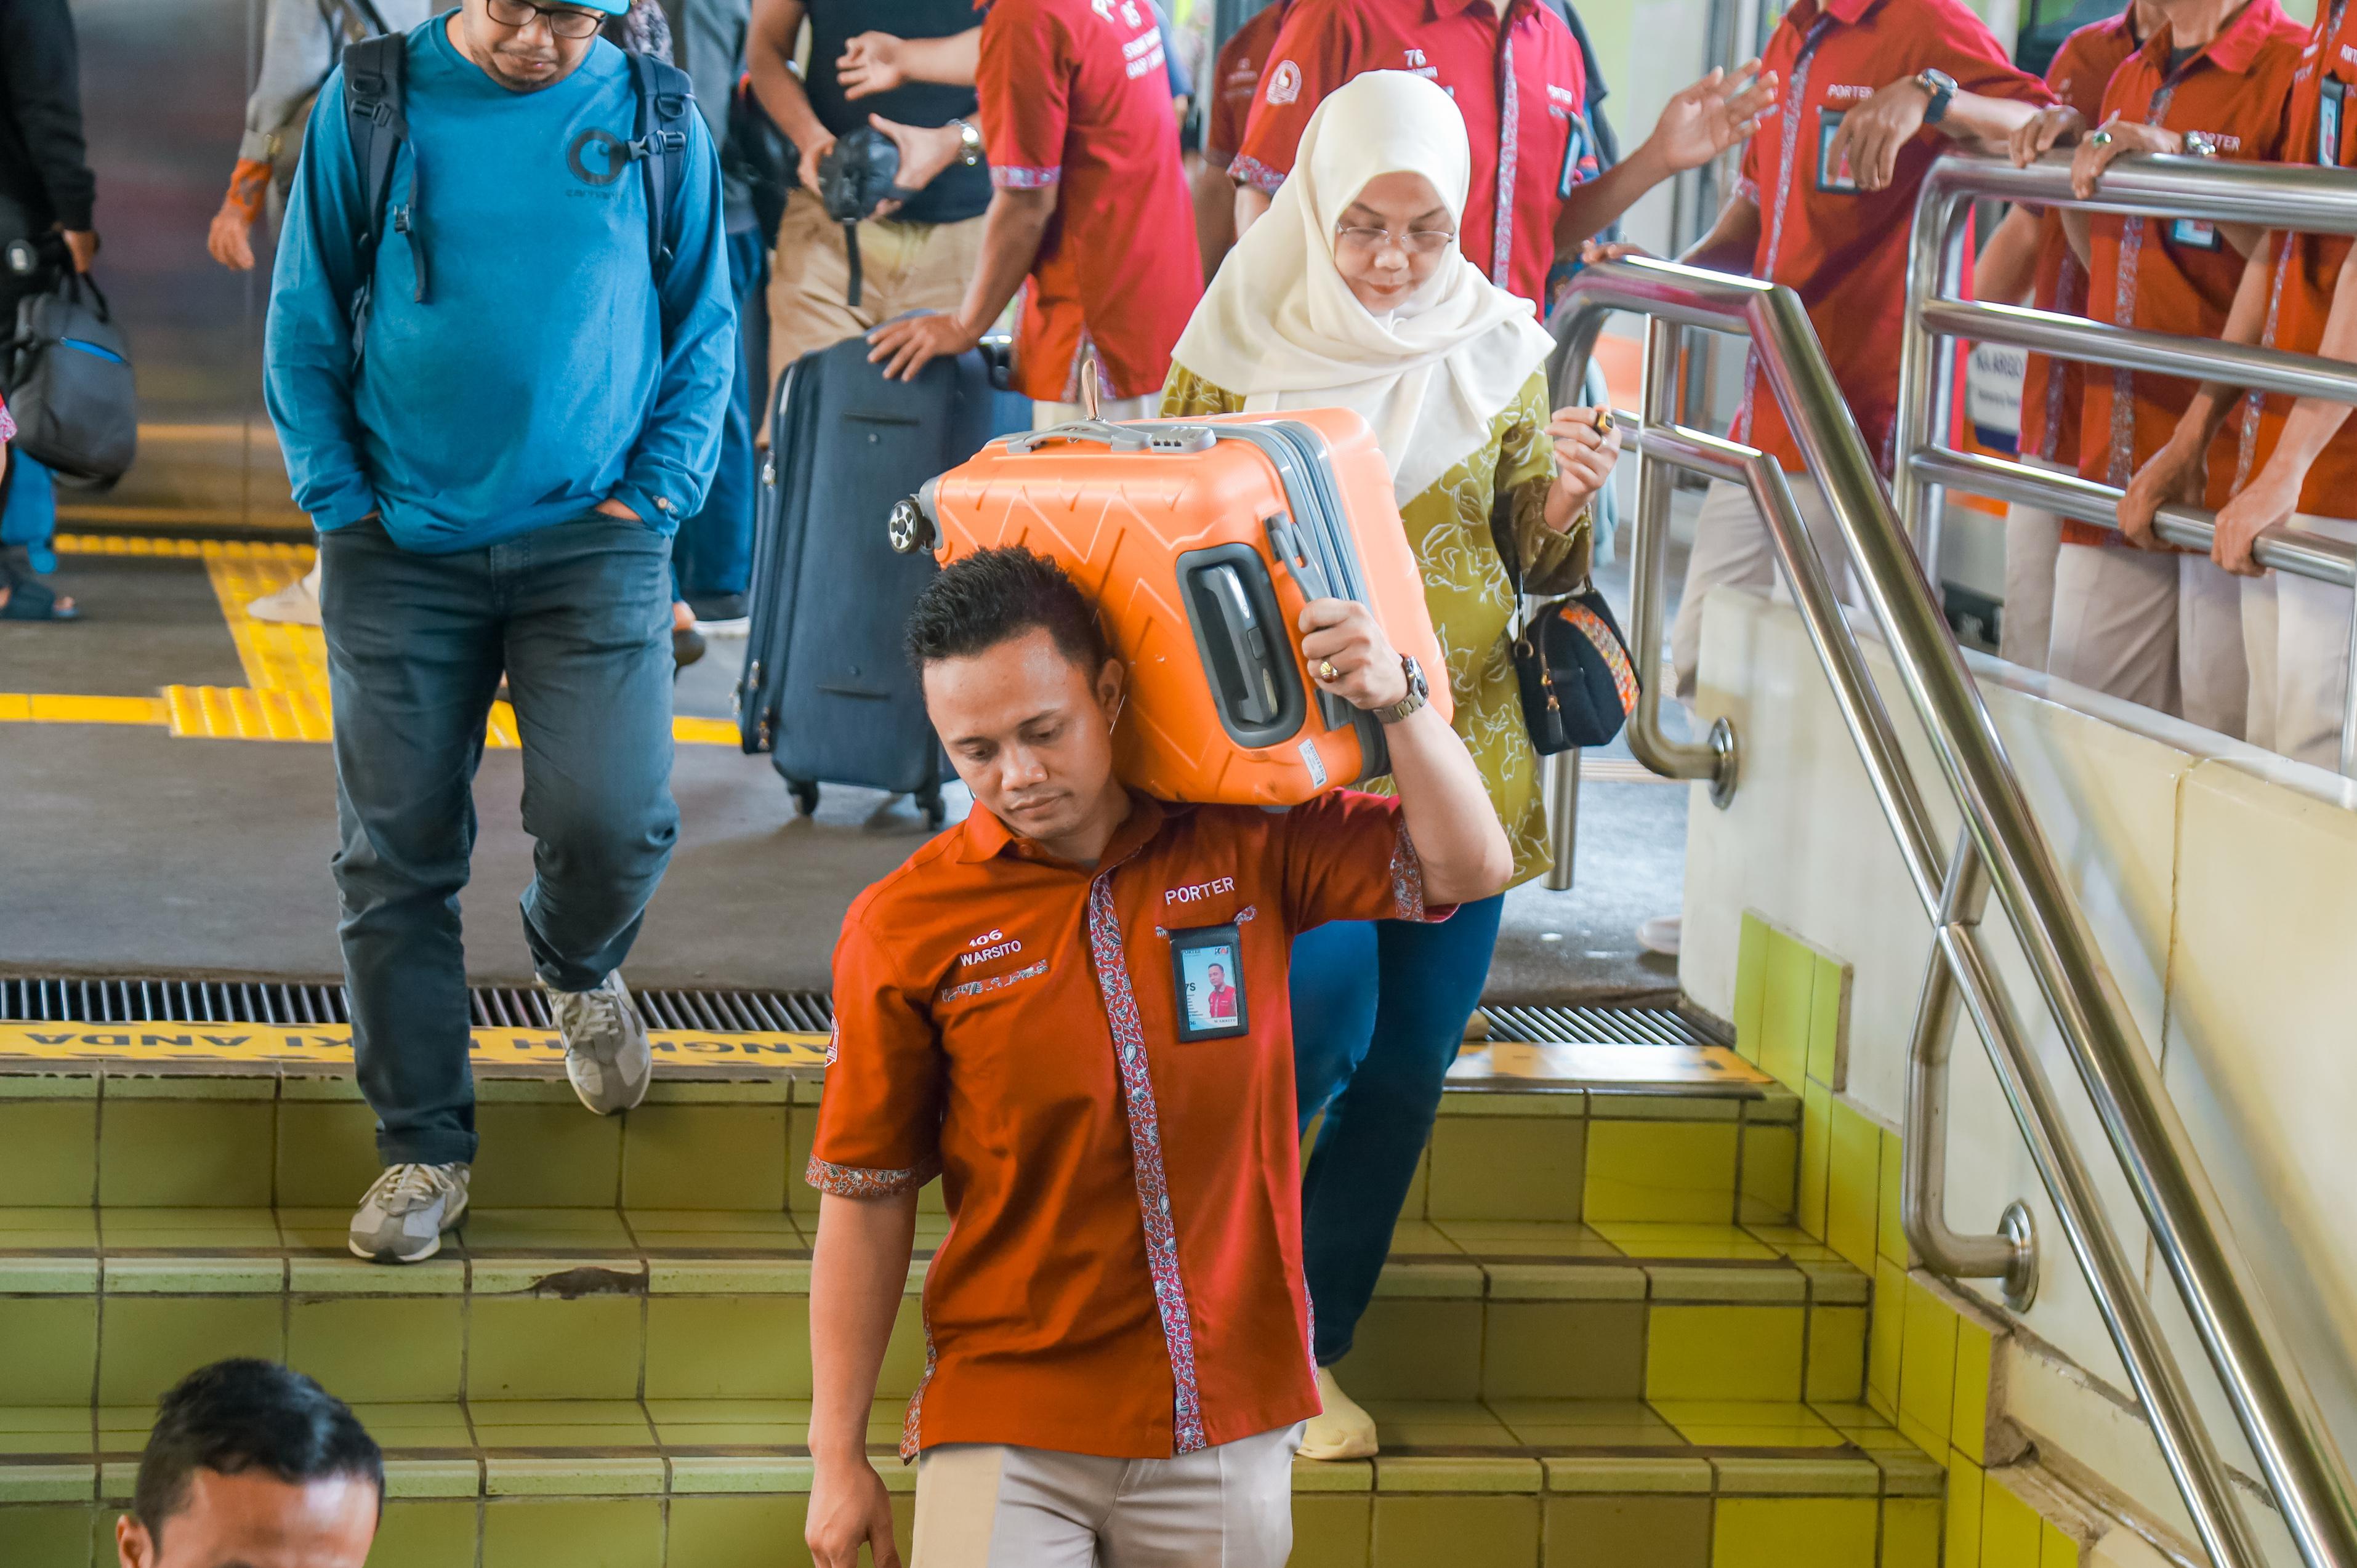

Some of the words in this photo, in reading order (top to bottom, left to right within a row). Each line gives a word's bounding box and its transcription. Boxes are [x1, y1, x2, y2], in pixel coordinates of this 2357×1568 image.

[1403, 49, 1427, 68] 76
[1164, 876, 1235, 906] PORTER
[969, 929, 1003, 947] 106
[961, 940, 1022, 967] WARSITO
[23, 1033, 252, 1046] ANDA
